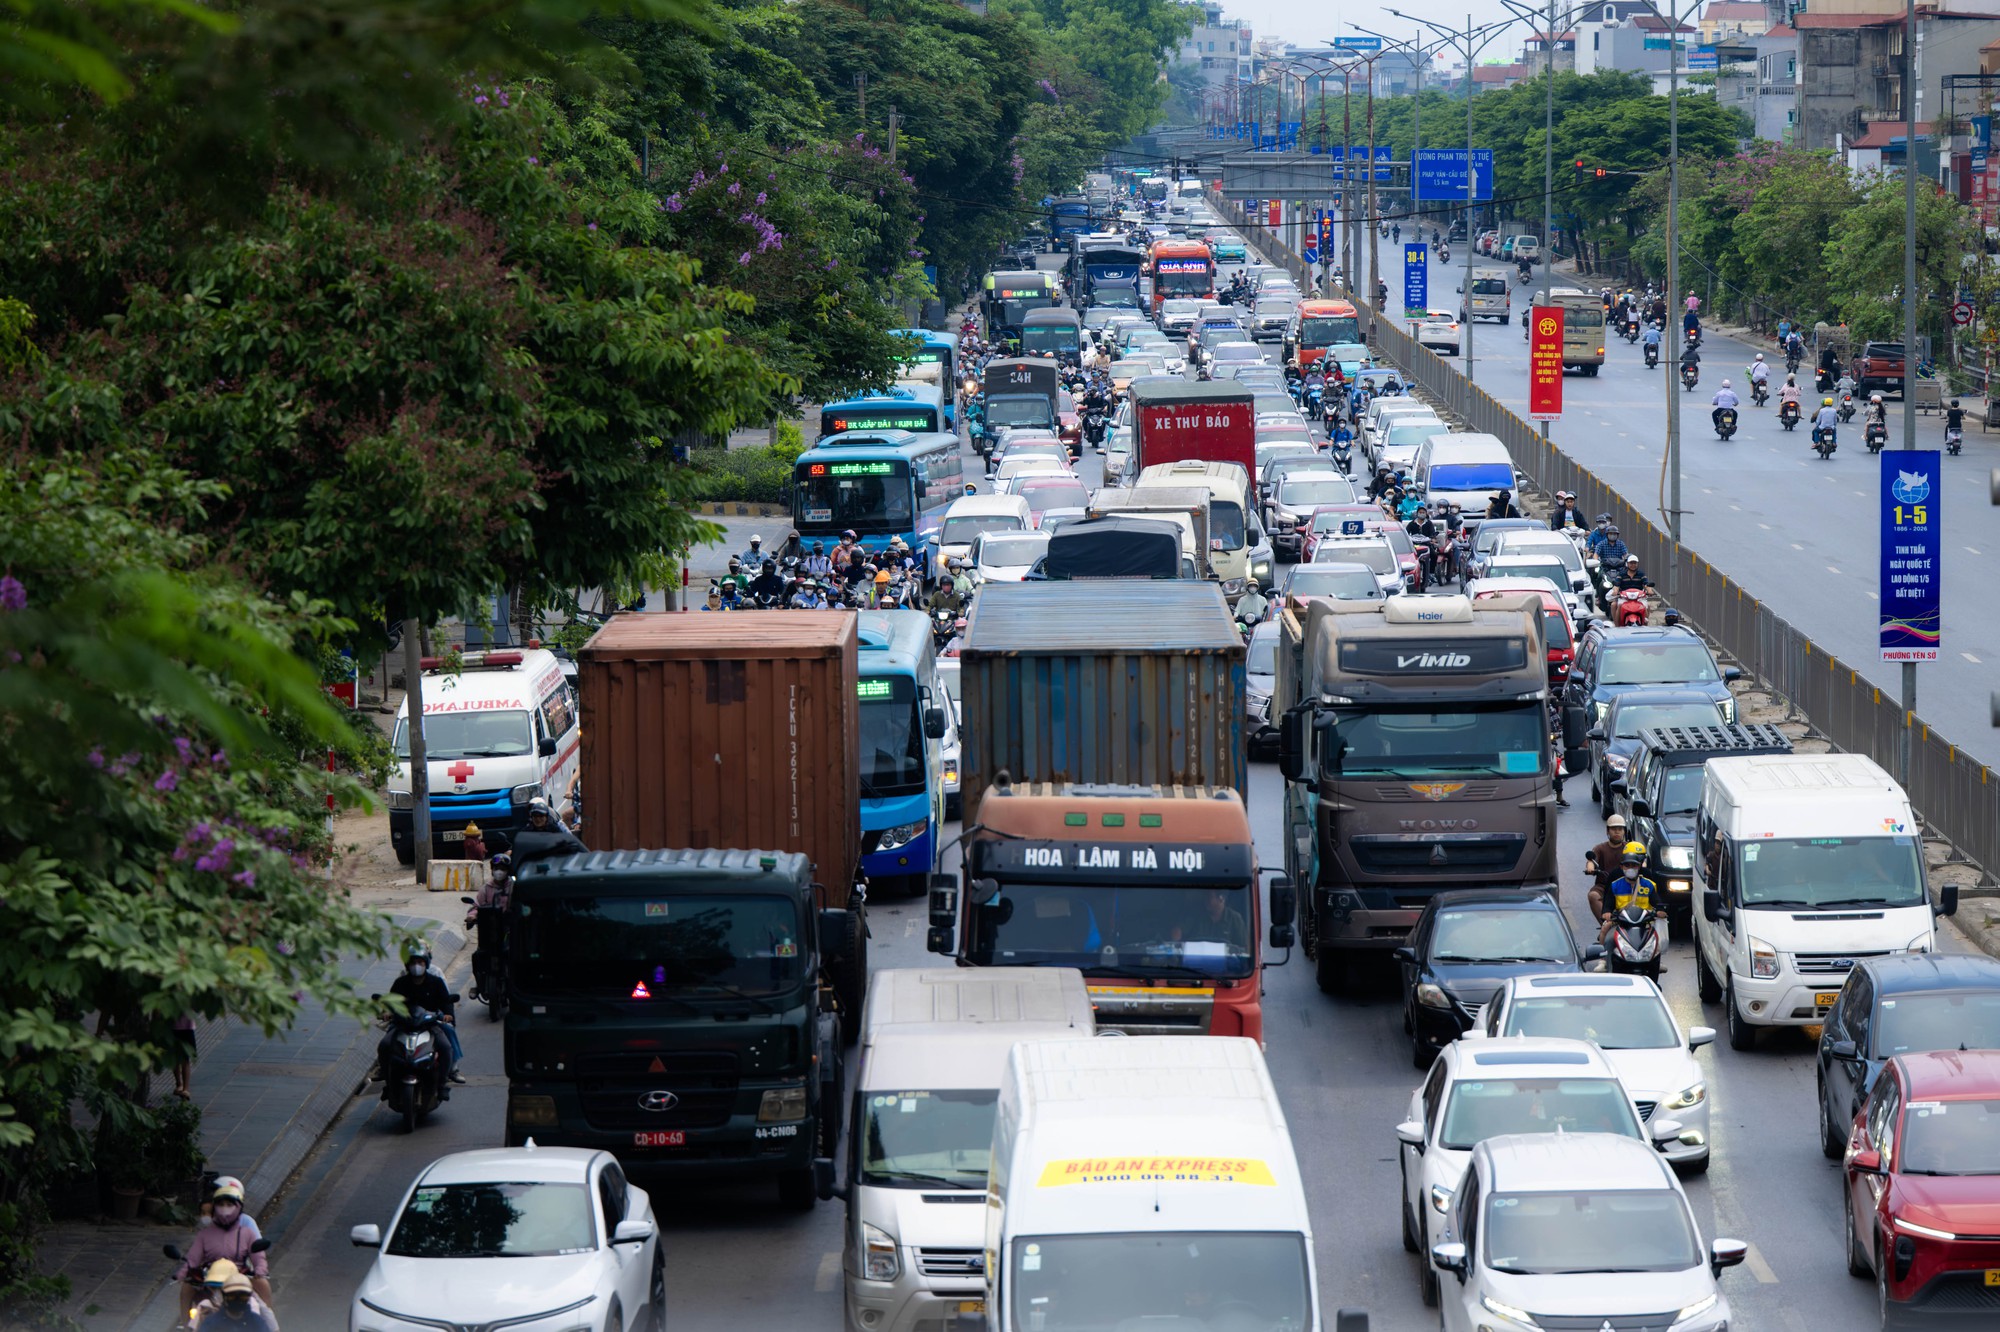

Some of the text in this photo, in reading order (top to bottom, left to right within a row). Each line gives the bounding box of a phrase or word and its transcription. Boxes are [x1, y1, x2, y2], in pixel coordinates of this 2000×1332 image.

[1415, 151, 1436, 160] ƯỜNG
[1437, 152, 1454, 160] PHAN
[1456, 152, 1476, 162] TRỌG
[1407, 251, 1424, 263] 30-4
[1010, 371, 1032, 383] 24H
[835, 420, 847, 429] 94
[1155, 410, 1230, 429] XE THƯ BÁO
[1893, 505, 1927, 525] 1-5
[1347, 522, 1359, 533] G7
[1895, 545, 1909, 555] TINH
[1890, 557, 1933, 570] NGÀY QUỐC TẾ
[1891, 572, 1930, 585] LAO ĐỘNG 1/5
[1895, 586, 1907, 598] BẤT
[1418, 612, 1443, 620] Haier
[1883, 649, 1937, 660] PHƯỜNG YÊN SỞ
[1399, 818, 1479, 830] HOWO
[1024, 846, 1202, 872] HOA LÂM HÀ NỘI
[755, 1126, 797, 1138] 44-CN06
[1113, 1160, 1145, 1172] AN
[1149, 1160, 1248, 1172] EXPRESS
